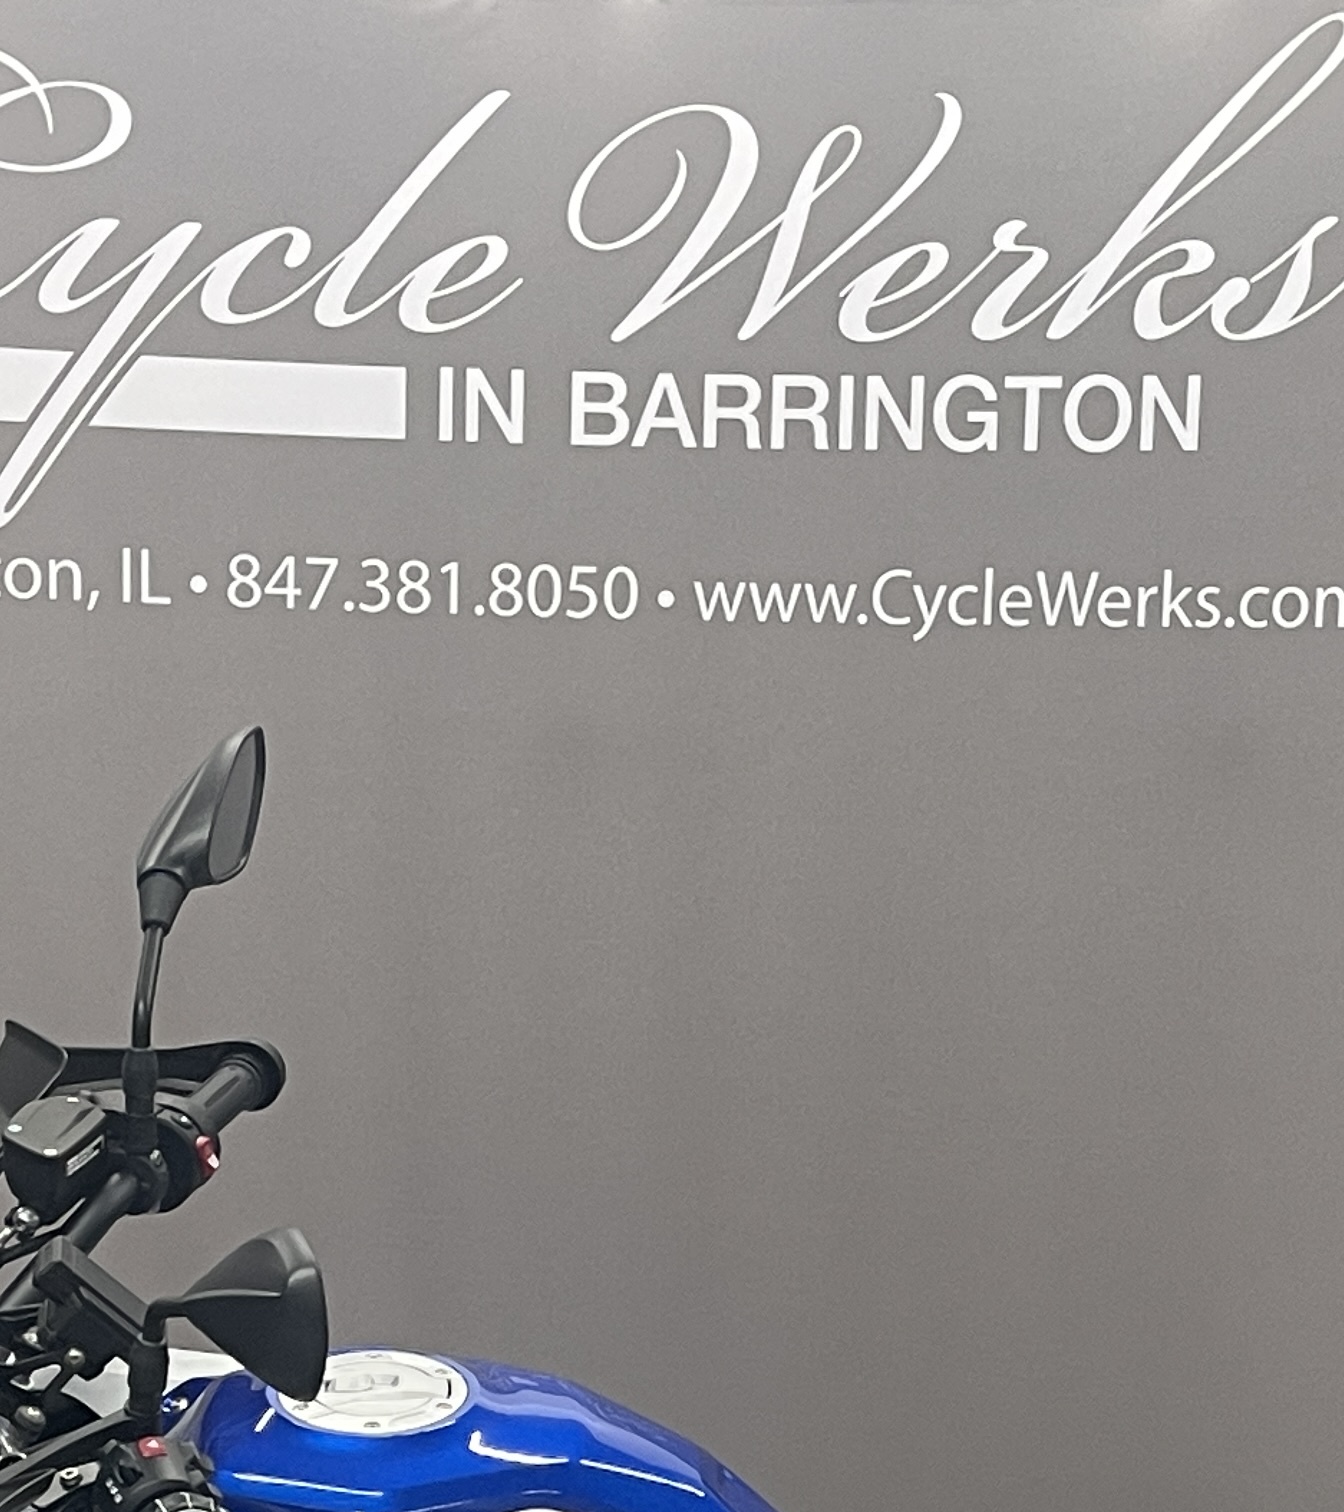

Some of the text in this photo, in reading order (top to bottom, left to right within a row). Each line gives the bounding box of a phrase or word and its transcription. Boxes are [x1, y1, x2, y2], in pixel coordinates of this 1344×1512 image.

[438, 366, 1203, 453] IN BARRINGTON
[122, 547, 173, 605] IL
[227, 553, 639, 621] 847.381.8050
